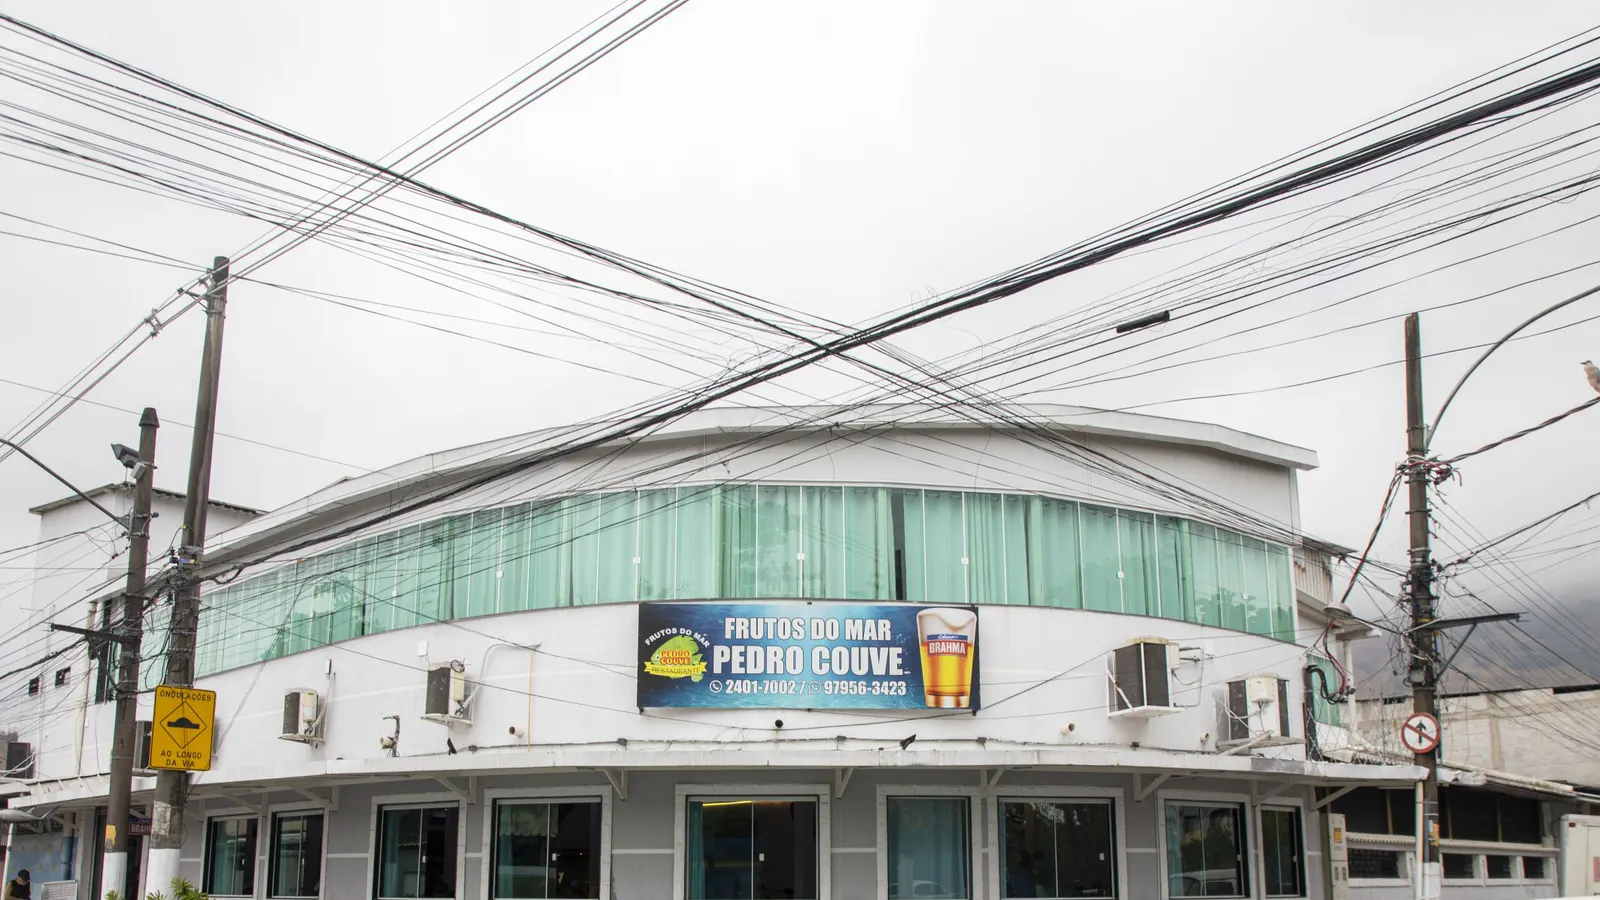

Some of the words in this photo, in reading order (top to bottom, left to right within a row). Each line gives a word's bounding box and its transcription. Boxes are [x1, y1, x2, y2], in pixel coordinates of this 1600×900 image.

[725, 617, 805, 640] FRUTOS
[811, 618, 839, 640] DO
[845, 619, 891, 641] MAR
[645, 628, 677, 646] FRUTOS
[680, 628, 692, 636] DO
[929, 641, 966, 655] BRAHMA
[660, 657, 690, 665] COUVE
[713, 645, 804, 675] PEDRO
[811, 646, 903, 676] COUVE
[725, 680, 796, 694] 2401-7002
[824, 680, 907, 696] 97956-3423
[160, 690, 212, 702] ONDULAÇÕES
[176, 751, 202, 759] LONGO
